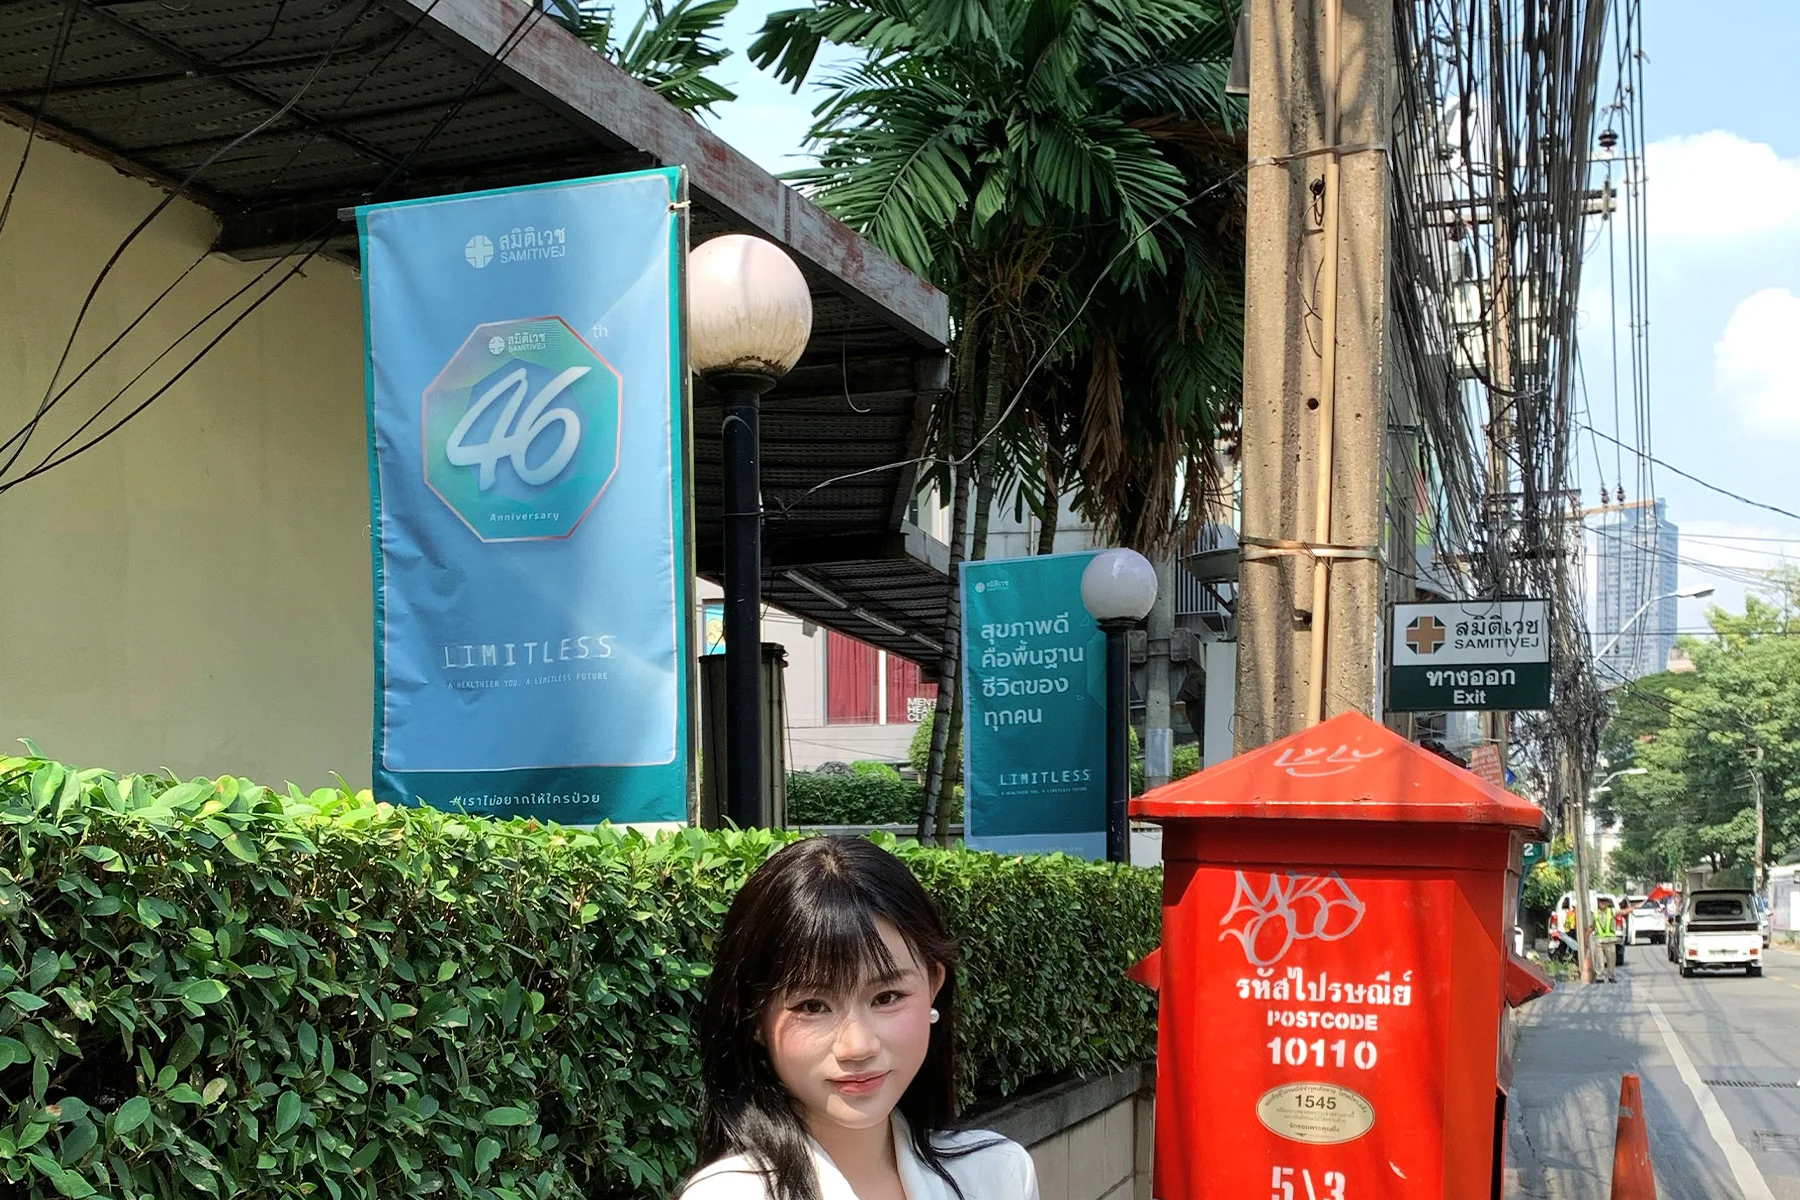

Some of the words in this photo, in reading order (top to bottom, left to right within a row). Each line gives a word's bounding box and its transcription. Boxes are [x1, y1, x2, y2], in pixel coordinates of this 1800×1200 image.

[499, 227, 566, 250] สมิติเวช
[500, 246, 566, 264] SAMITIVEJ
[592, 324, 608, 338] th
[445, 366, 592, 492] 46
[489, 510, 560, 523] Anniversary
[980, 611, 1070, 645] สุขภาพดี
[1455, 615, 1539, 637] สมิติเวช
[443, 635, 615, 669] LIMITLESS
[1454, 637, 1539, 650] SAMITIVEJ
[981, 640, 1084, 670] คือพื้นฐาน
[576, 671, 608, 681] FUTURE
[1426, 668, 1516, 687] ทางออก
[982, 676, 1070, 698] ชีวิตของ
[1453, 690, 1487, 705] Exit
[984, 707, 1043, 732] ทุกคน
[999, 769, 1091, 786] LIMITLESS
[1236, 967, 1413, 1006] รหัสไปรษณีย์
[1267, 1010, 1379, 1031] POSTCODE
[1266, 1036, 1378, 1071] 10110
[1295, 1094, 1337, 1110] 1545
